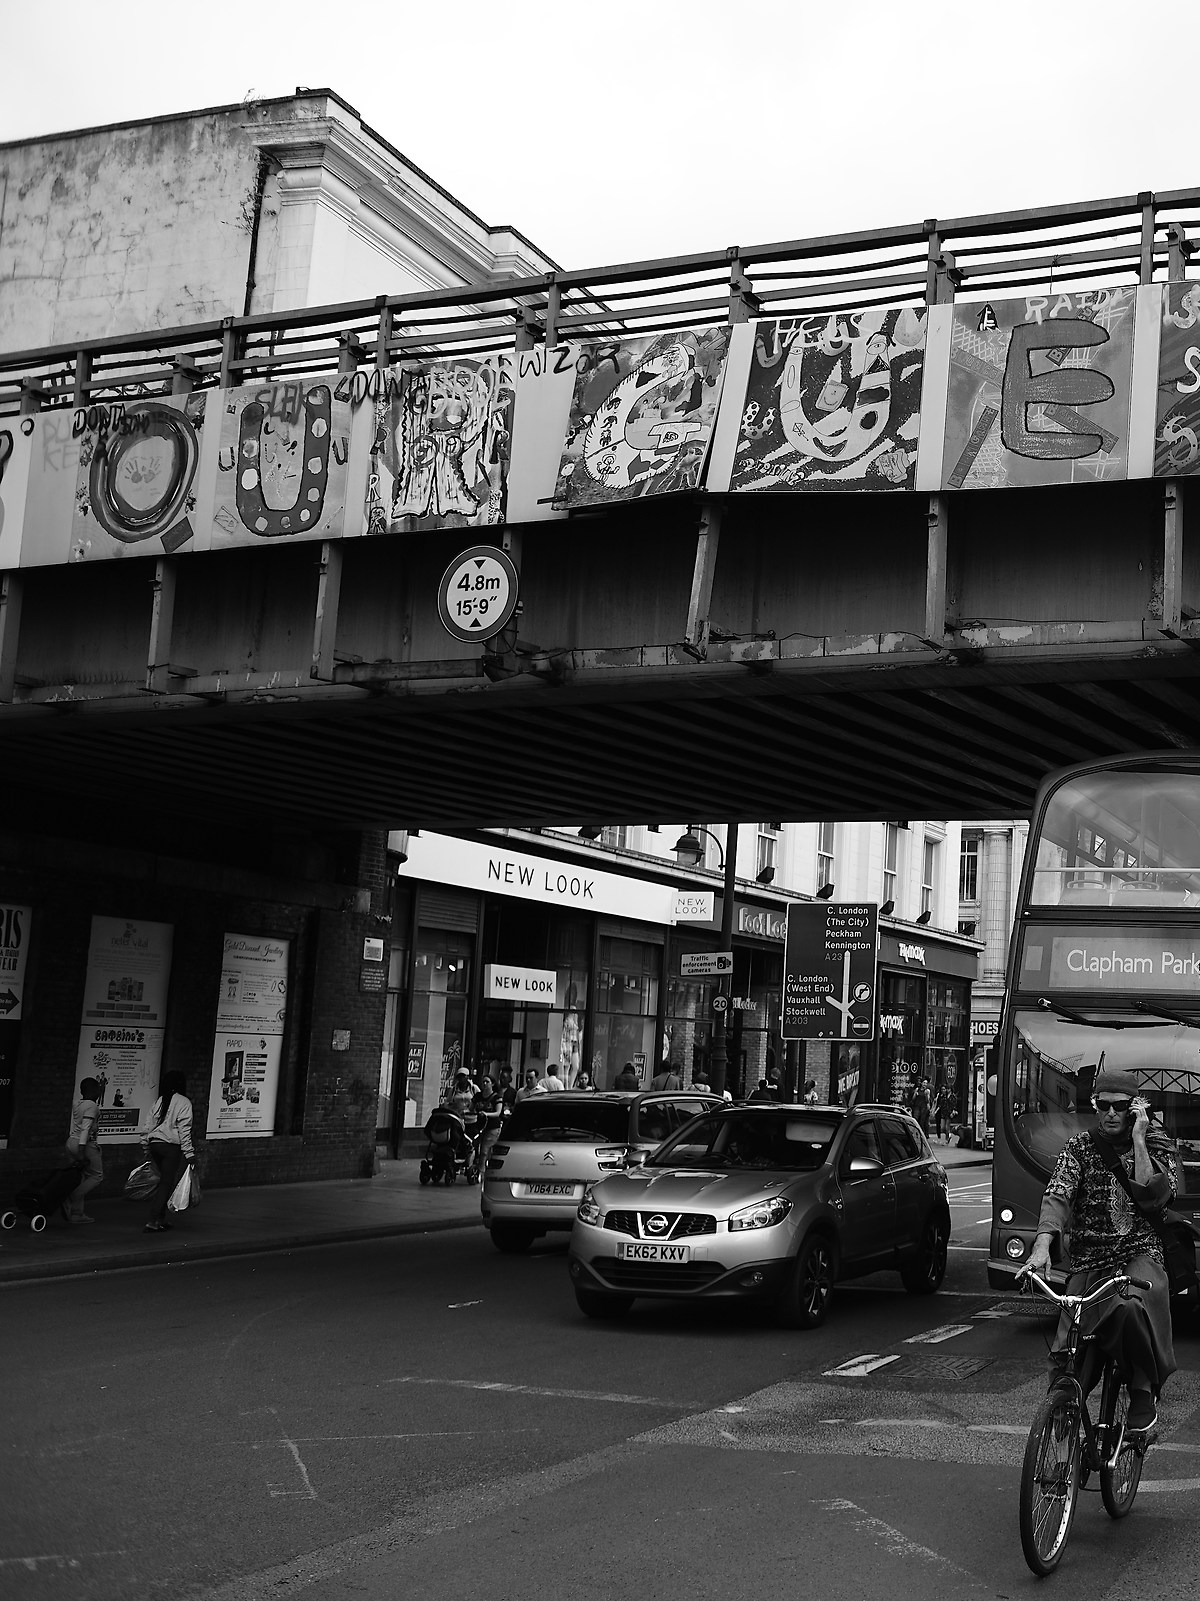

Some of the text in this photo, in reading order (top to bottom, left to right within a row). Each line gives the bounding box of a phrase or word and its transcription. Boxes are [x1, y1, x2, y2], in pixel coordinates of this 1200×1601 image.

[457, 572, 501, 592] 4.8m
[488, 859, 595, 899] NEW LOOK
[677, 898, 705, 906] NEW
[675, 907, 707, 915] LOOK
[827, 906, 869, 915] C. London
[739, 907, 766, 936] Foot
[826, 917, 870, 927] (The City)
[825, 929, 862, 938] Peckham
[825, 940, 871, 951] Kennington
[824, 952, 843, 961] A23
[1066, 949, 1153, 979] Clapham
[787, 974, 828, 983] C. London
[495, 976, 553, 993] NEW LOOK
[786, 984, 835, 993] (West End)
[786, 995, 821, 1004] Vauxhall
[714, 1001, 727, 1009] 20
[785, 1007, 826, 1016] Stockwell
[785, 1016, 808, 1025] A203
[971, 1021, 999, 1035] HOES
[409, 1048, 422, 1057] ALE
[529, 1183, 571, 1195] YD64 EXC
[626, 1245, 685, 1260] EK62 KXV
